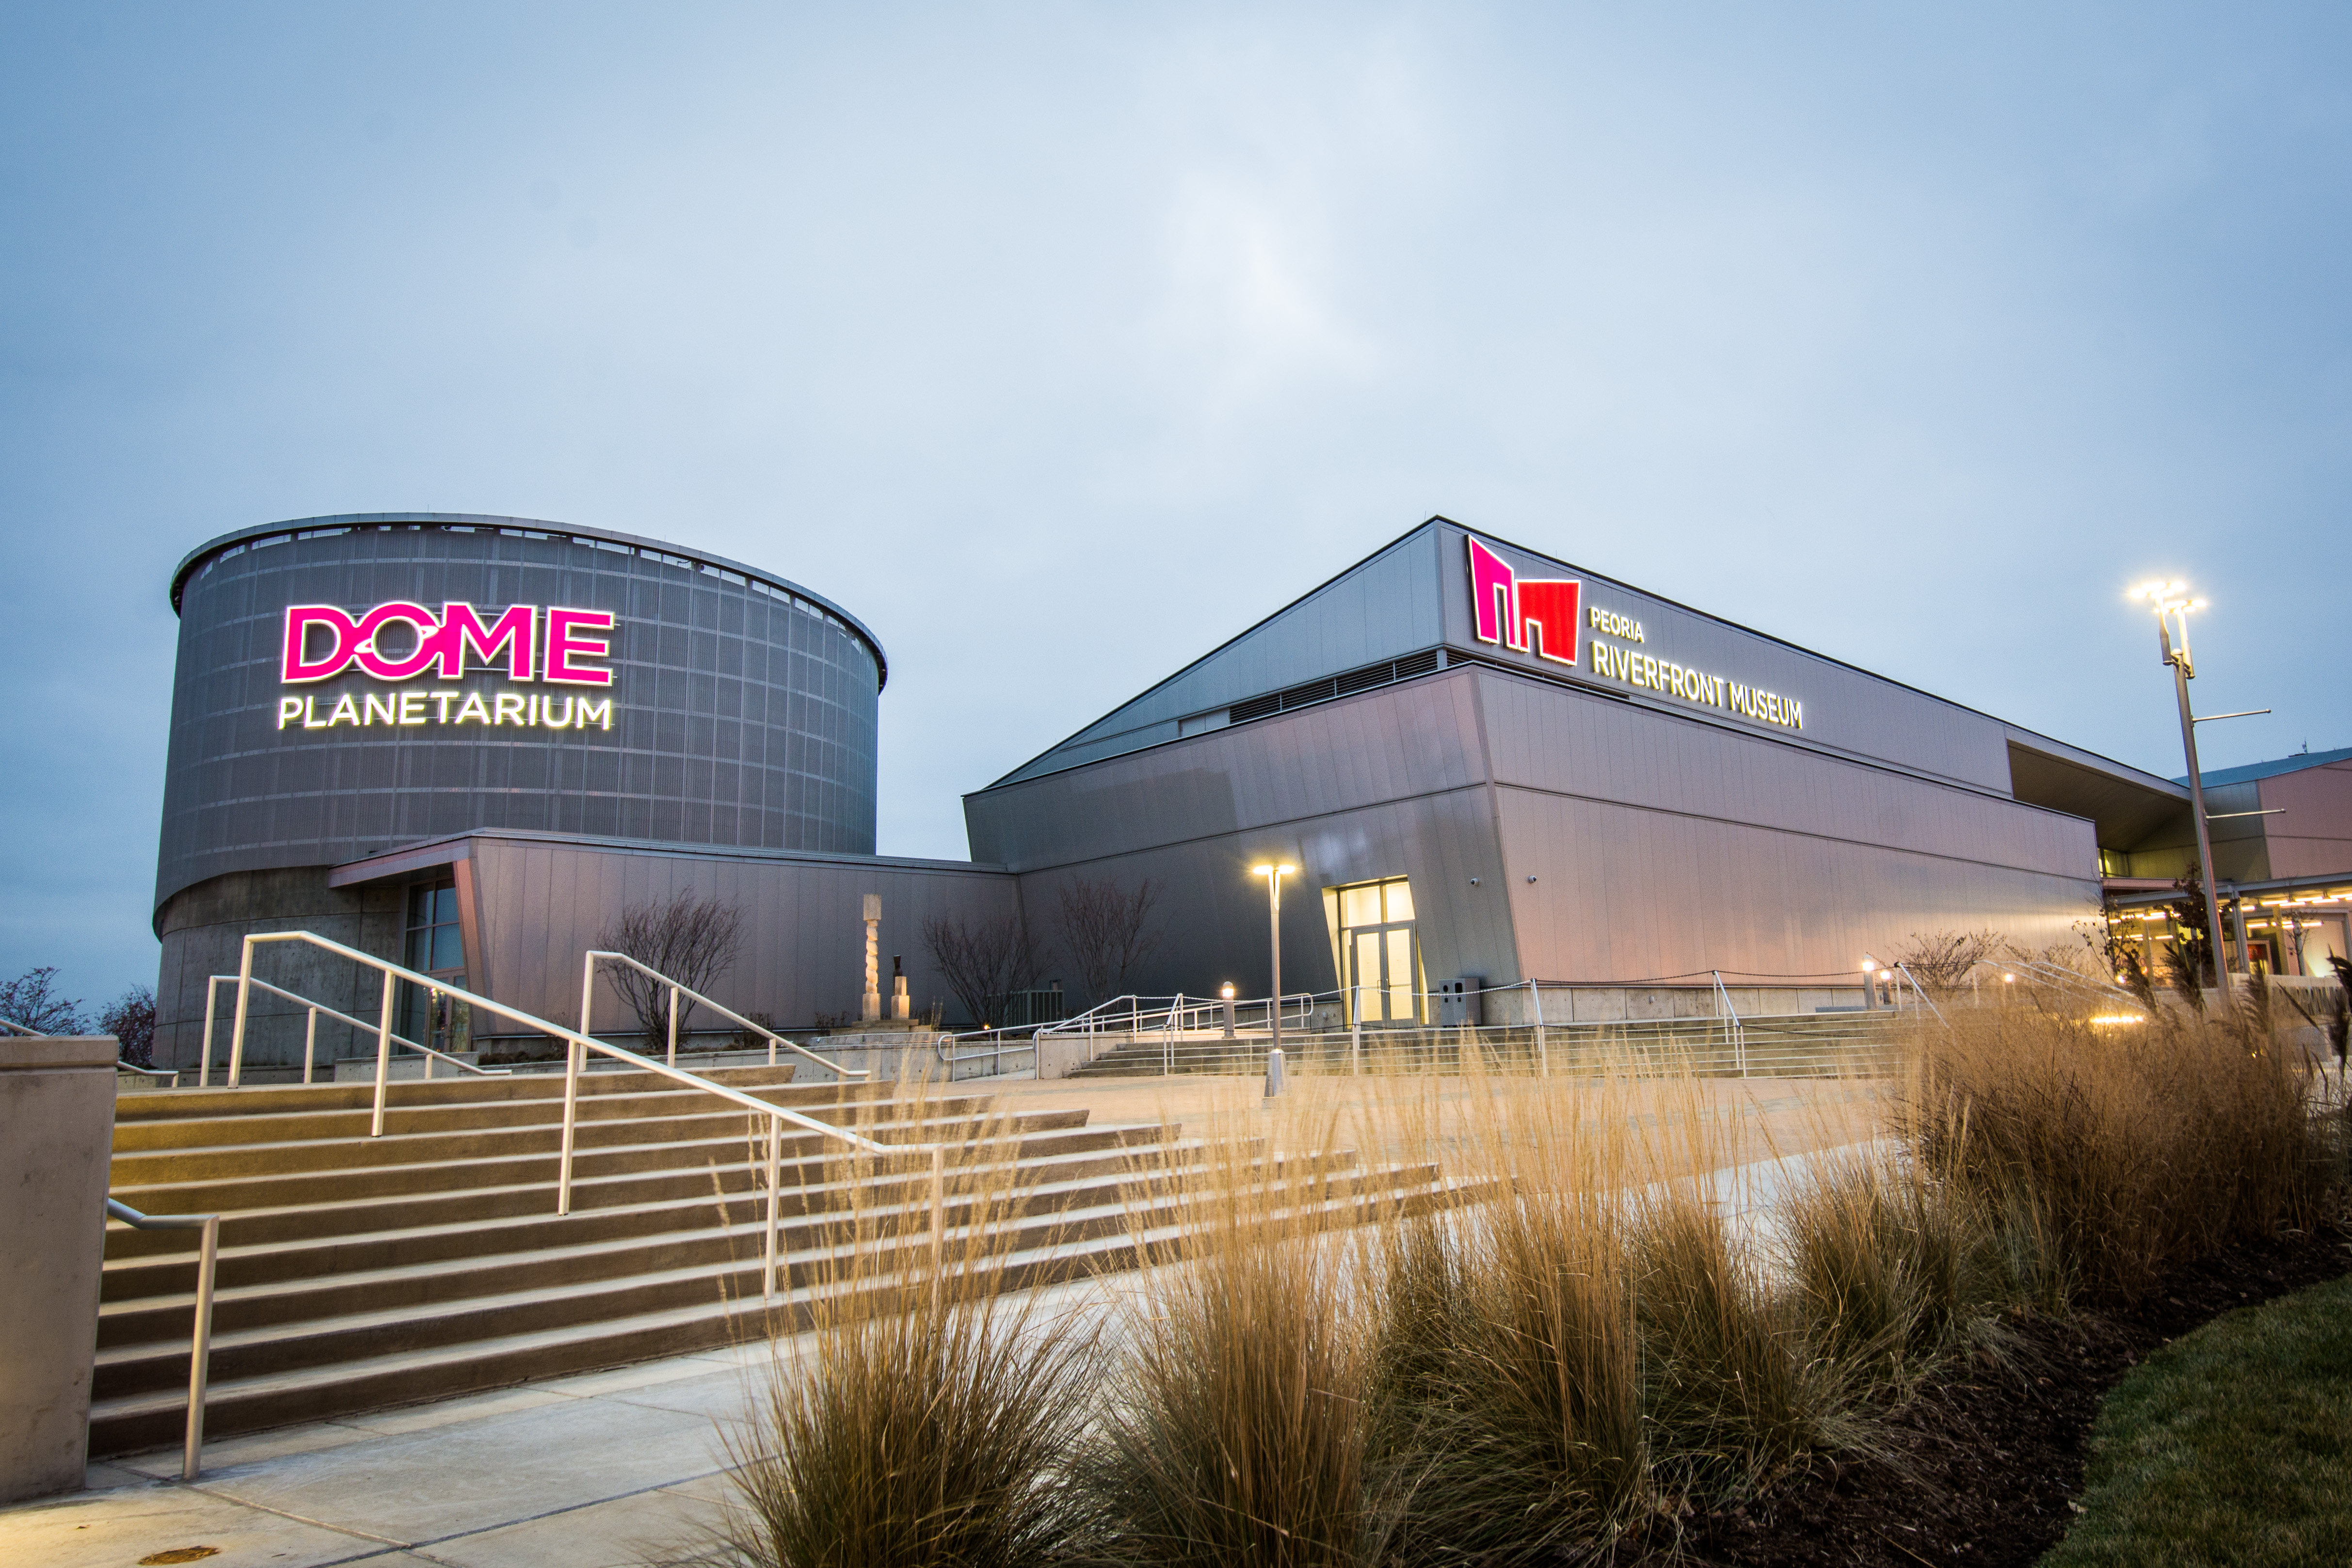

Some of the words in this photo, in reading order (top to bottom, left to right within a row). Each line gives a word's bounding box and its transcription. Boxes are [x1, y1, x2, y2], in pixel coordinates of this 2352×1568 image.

[281, 601, 615, 686] DOME
[1590, 606, 1645, 643] PEORIA
[278, 692, 611, 730] PLANETARIUM
[1592, 640, 1724, 707] RIVERFRONT
[1729, 681, 1803, 729] MUSEUM
